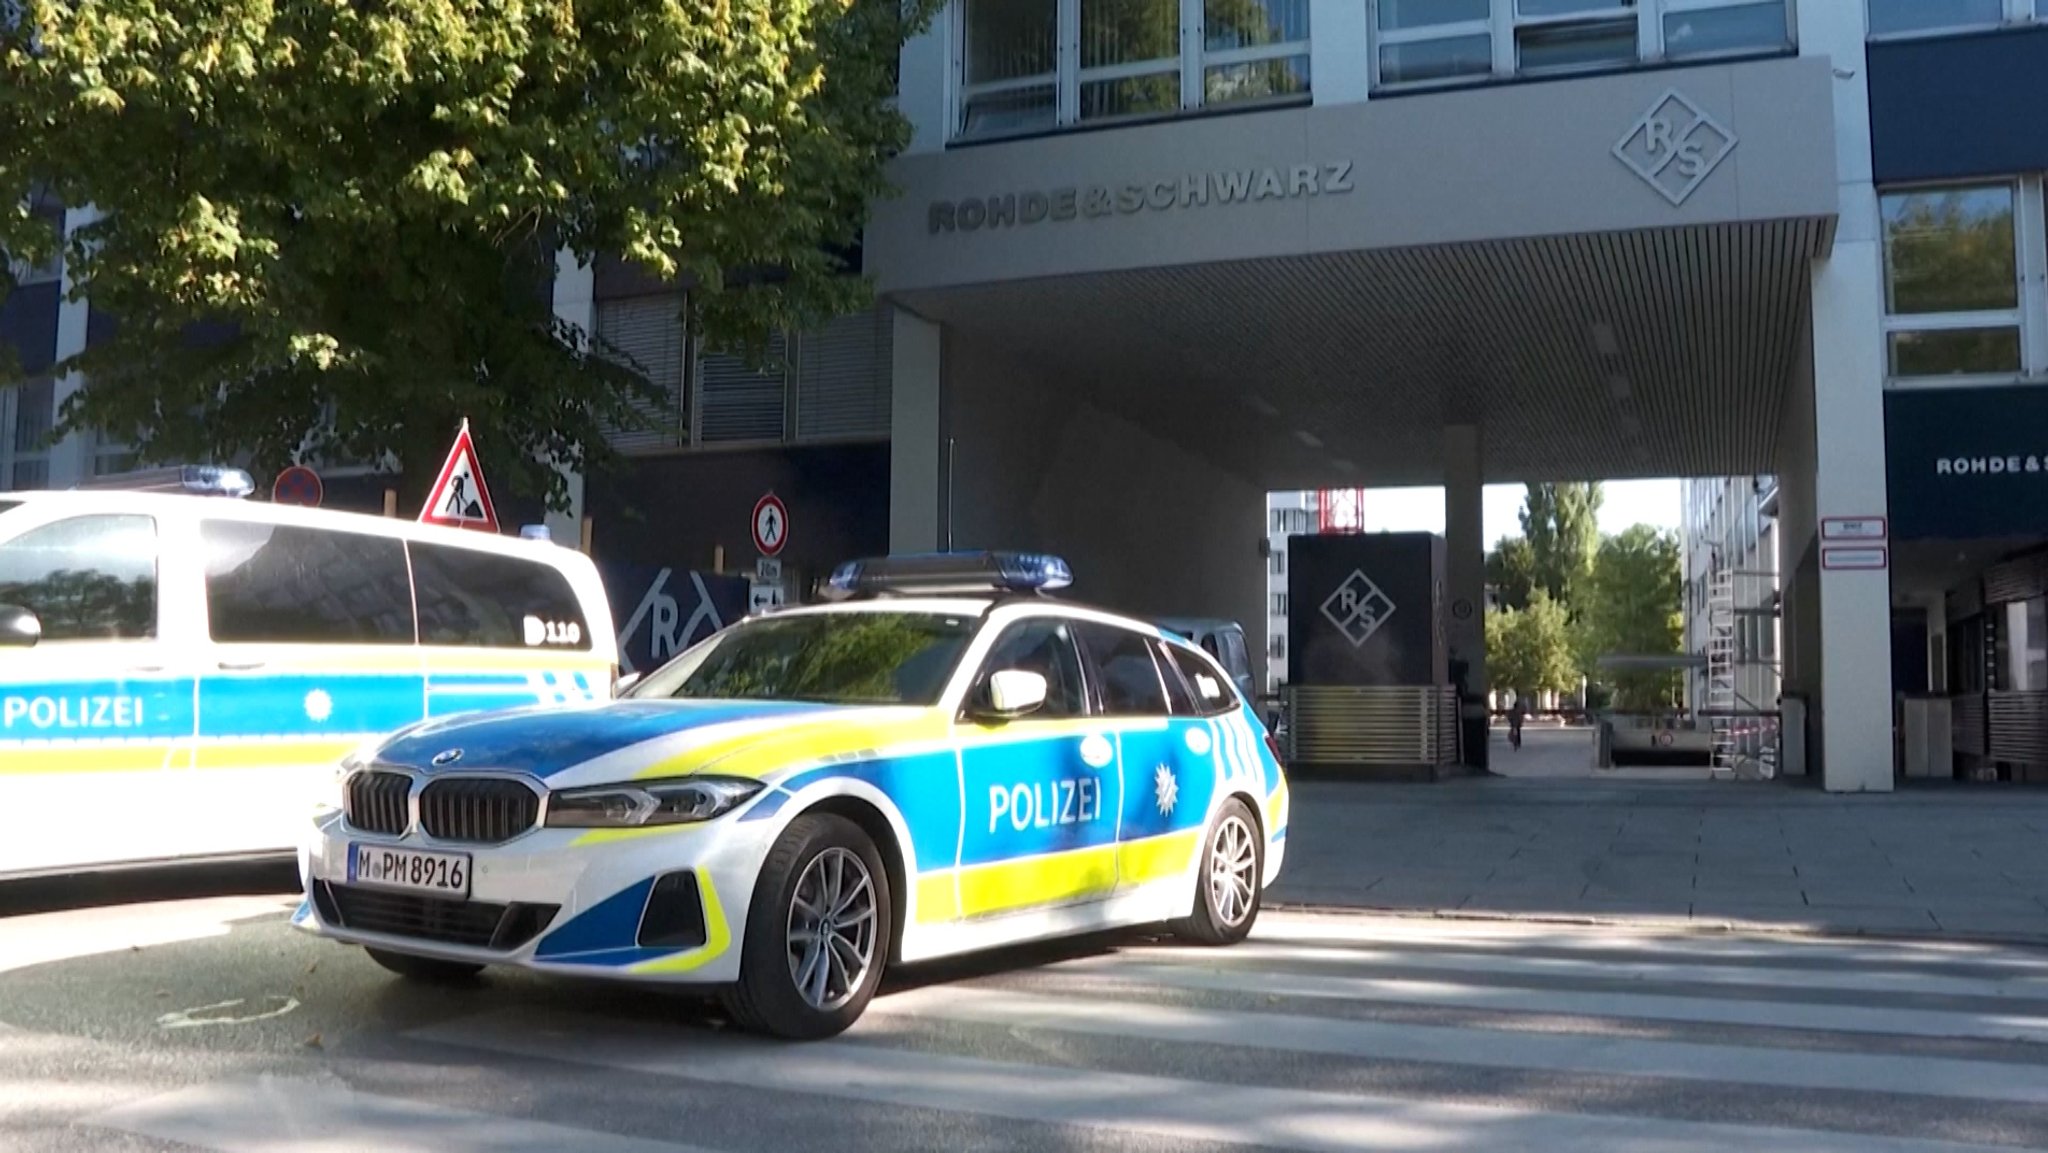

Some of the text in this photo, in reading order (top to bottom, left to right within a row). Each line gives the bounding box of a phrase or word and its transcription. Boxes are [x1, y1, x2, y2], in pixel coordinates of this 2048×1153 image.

[4, 696, 143, 728] POLIZEI
[989, 777, 1101, 834] POLIZEI
[358, 850, 371, 878] M
